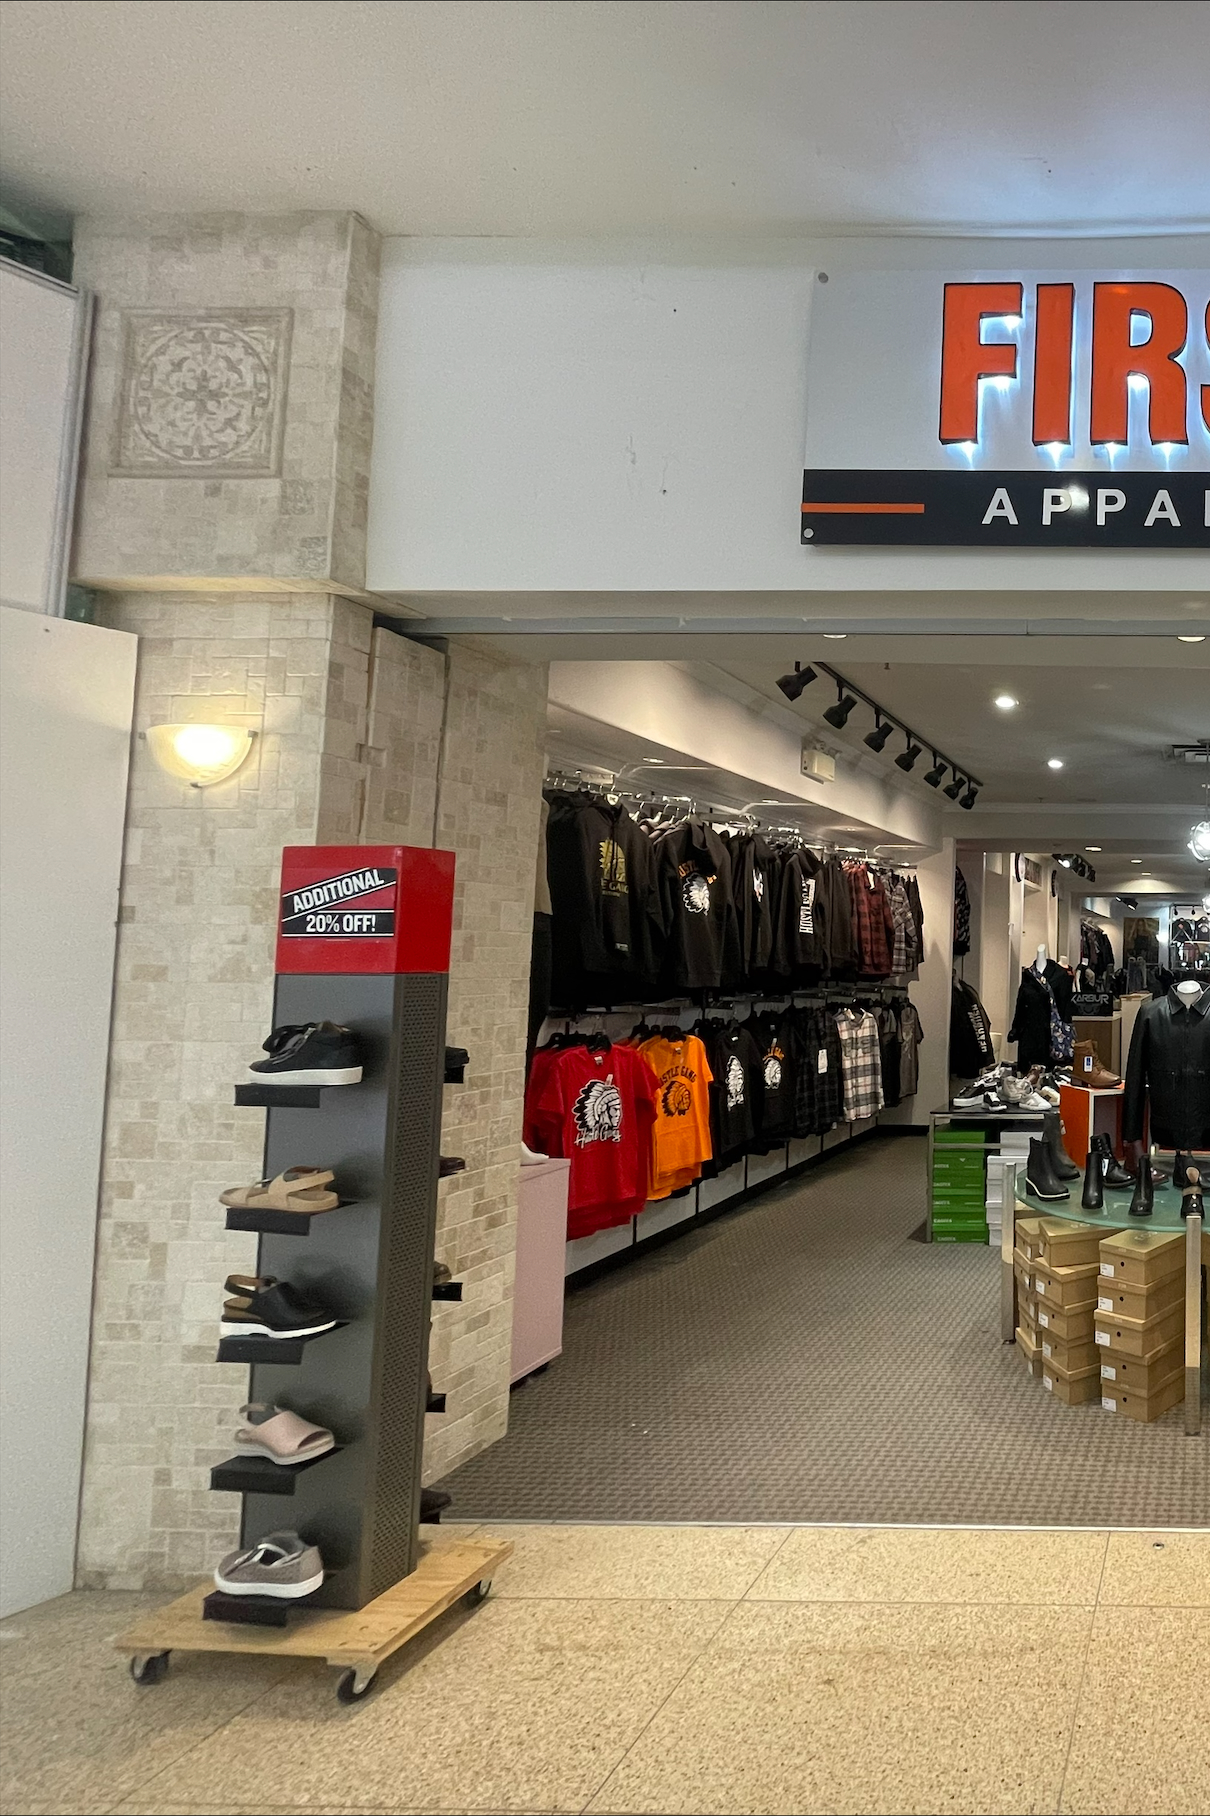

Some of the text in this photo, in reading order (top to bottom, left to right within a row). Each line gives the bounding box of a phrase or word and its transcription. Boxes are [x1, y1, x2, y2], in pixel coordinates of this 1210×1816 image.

[292, 869, 385, 913] ADDITIONAL
[305, 914, 376, 932] 20% OFF!
